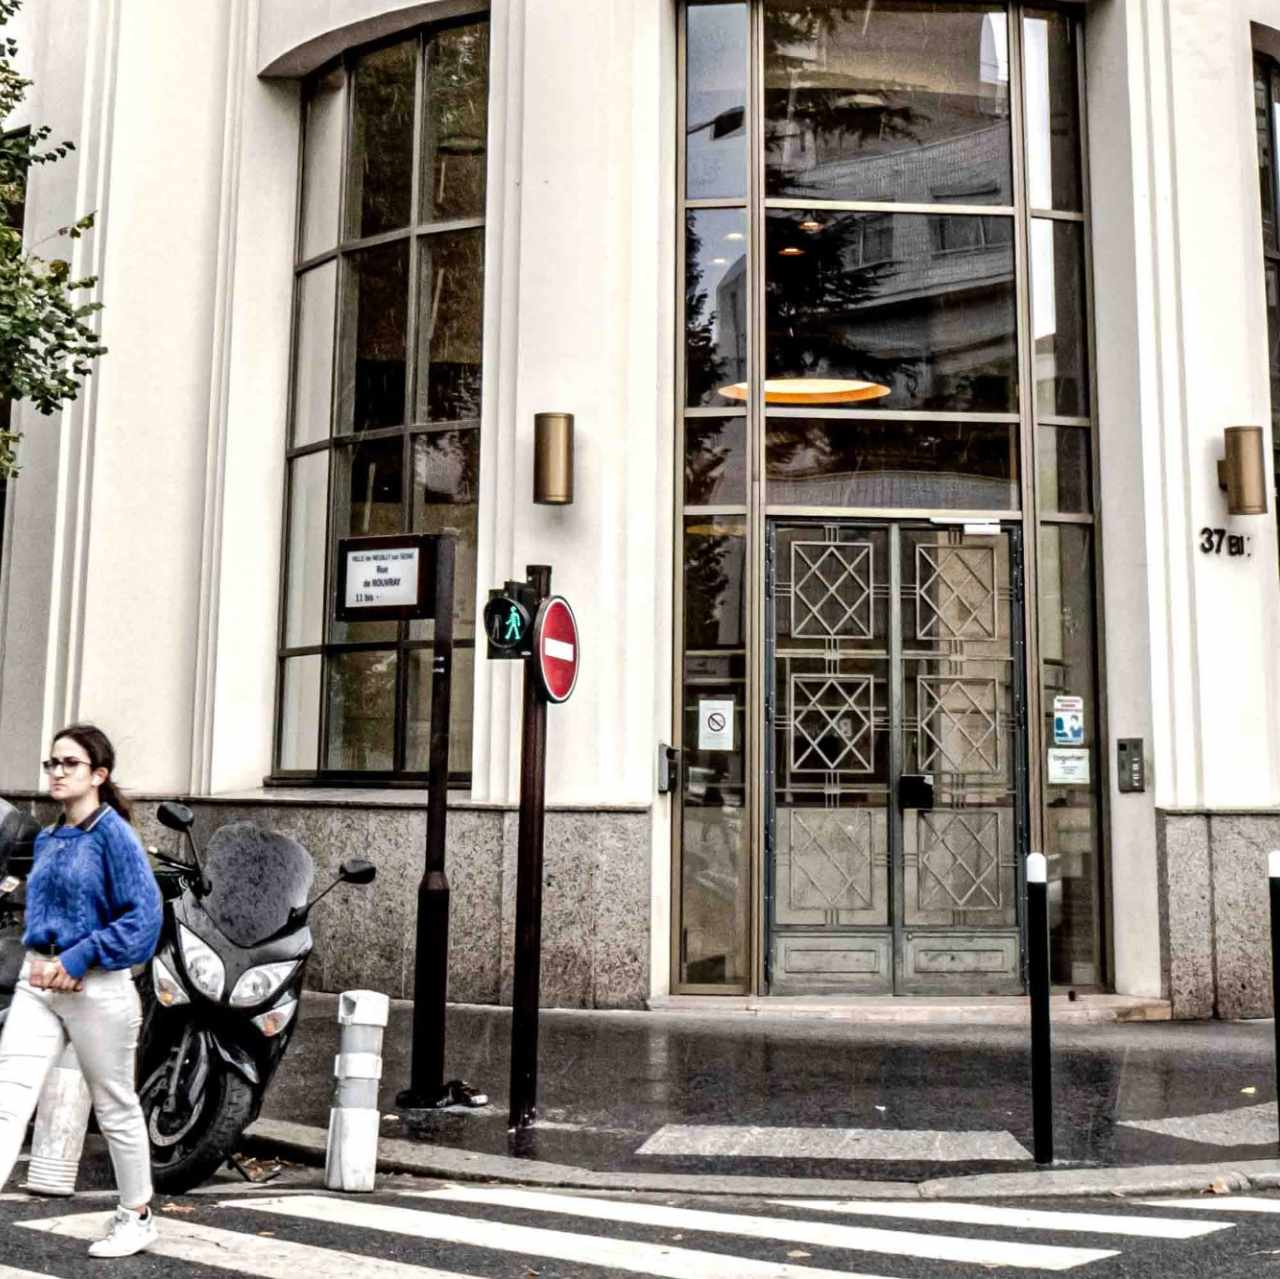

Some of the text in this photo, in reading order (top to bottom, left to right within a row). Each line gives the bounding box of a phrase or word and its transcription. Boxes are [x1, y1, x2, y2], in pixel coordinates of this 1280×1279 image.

[1200, 527, 1226, 554] 37
[376, 565, 389, 574] Rue
[363, 579, 371, 588] de
[355, 593, 374, 602] 11 bis
